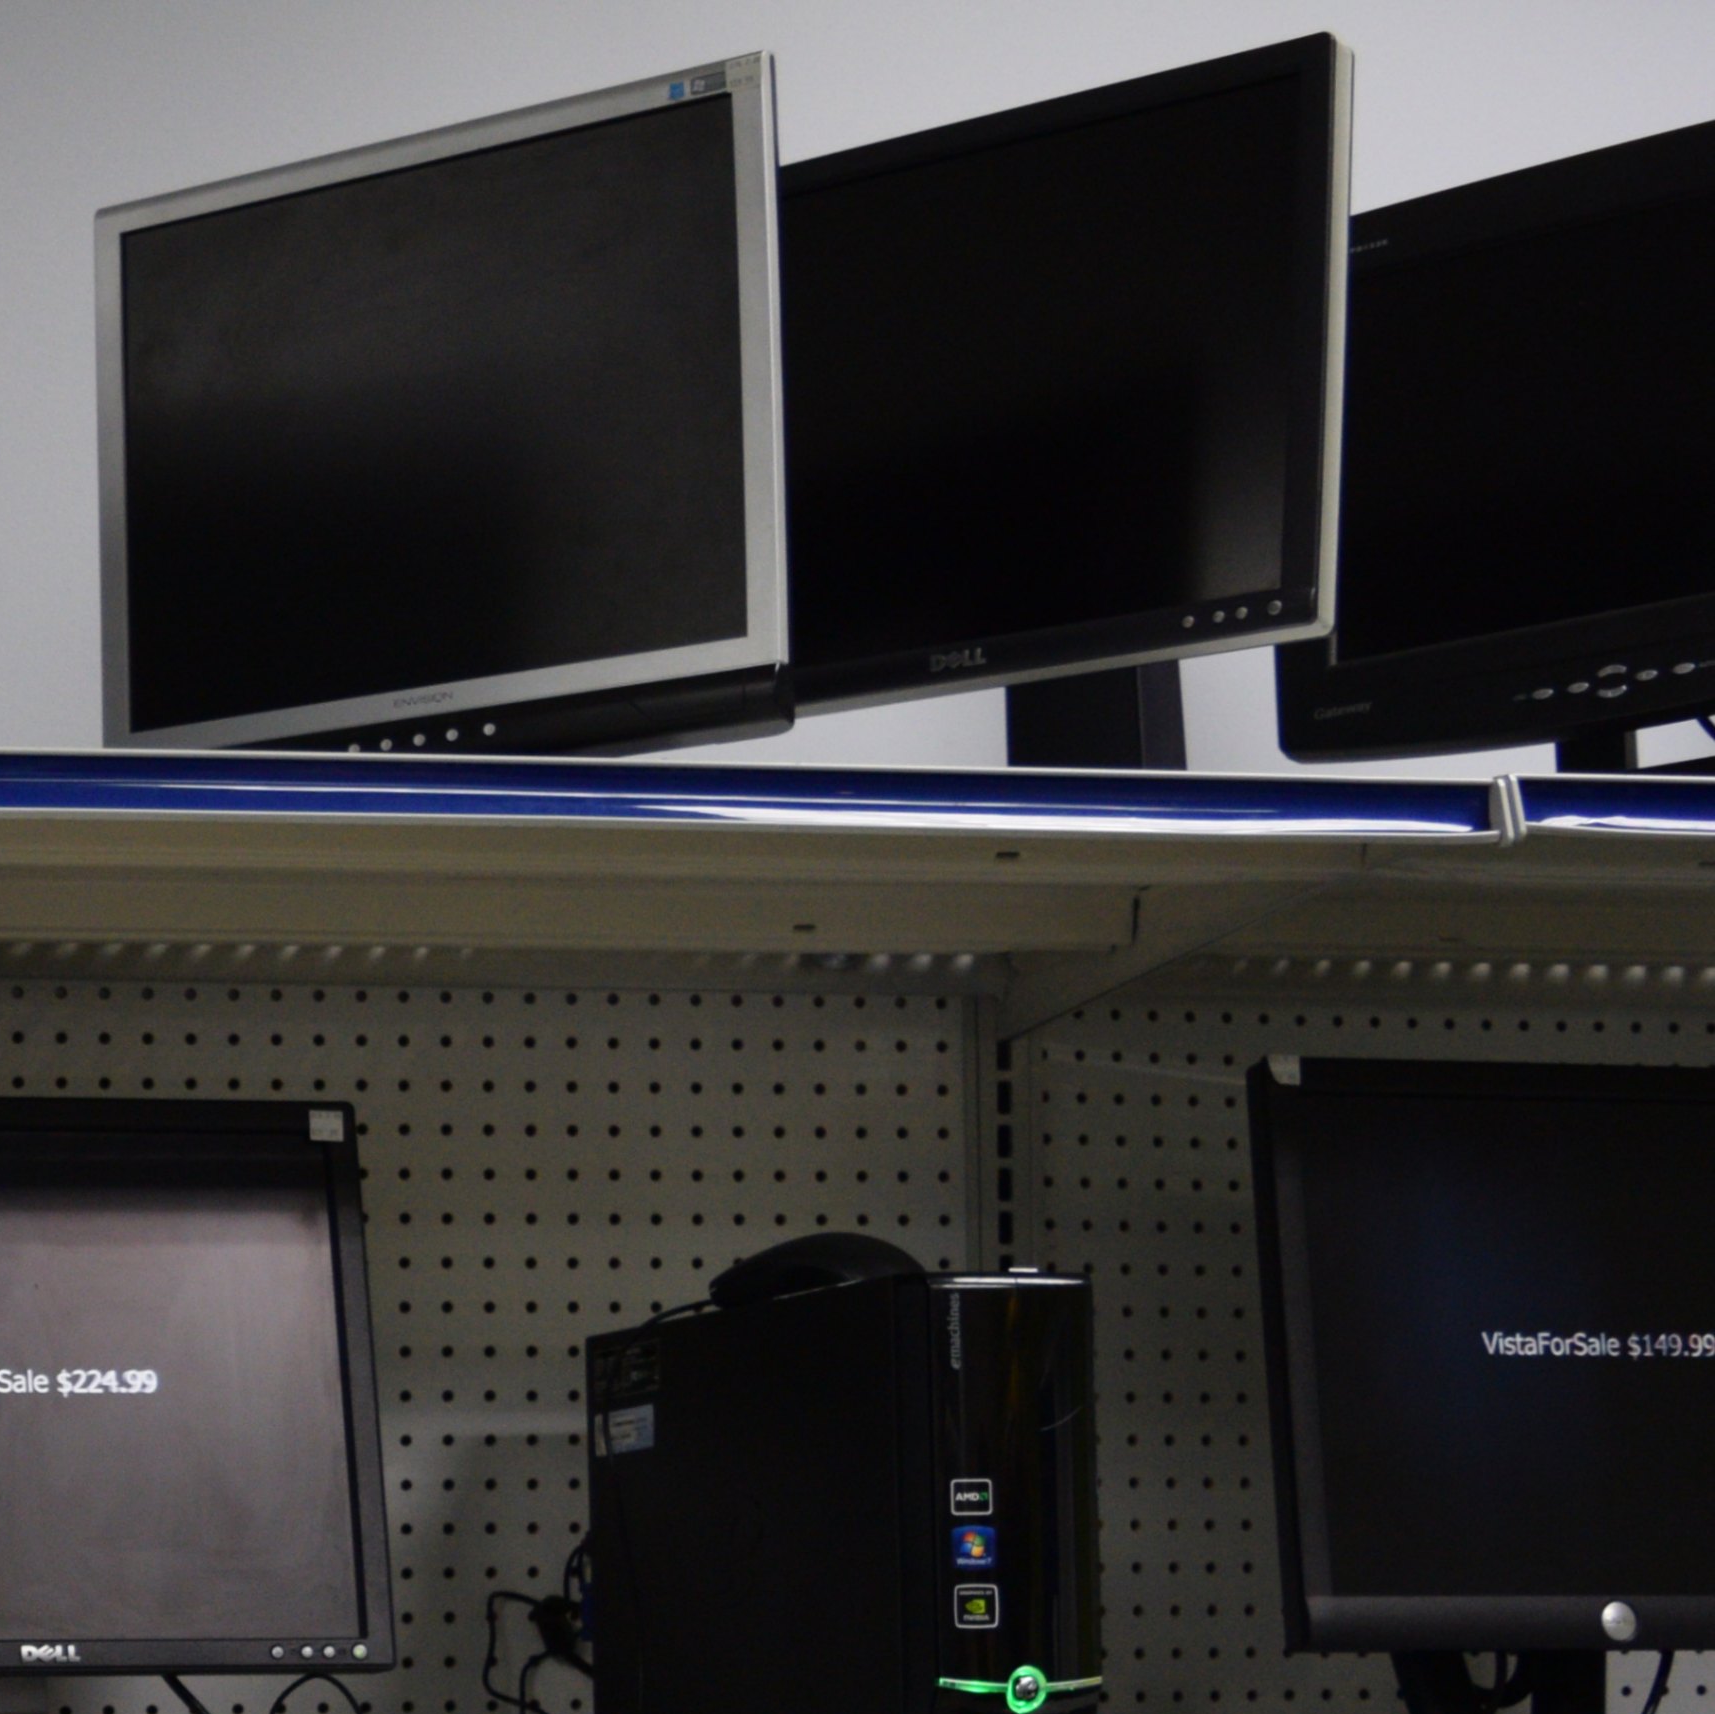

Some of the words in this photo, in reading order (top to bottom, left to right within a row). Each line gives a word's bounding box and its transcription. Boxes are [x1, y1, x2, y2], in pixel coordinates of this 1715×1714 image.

[929, 646, 987, 673] DELL
[1312, 701, 1373, 721] Gateway
[1479, 1330, 1621, 1358] VistaForSale
[1626, 1332, 1715, 1361] $149.99
[56, 1368, 159, 1398] $224.99
[955, 1491, 981, 1502] AMD
[20, 1644, 81, 1663] DELL
